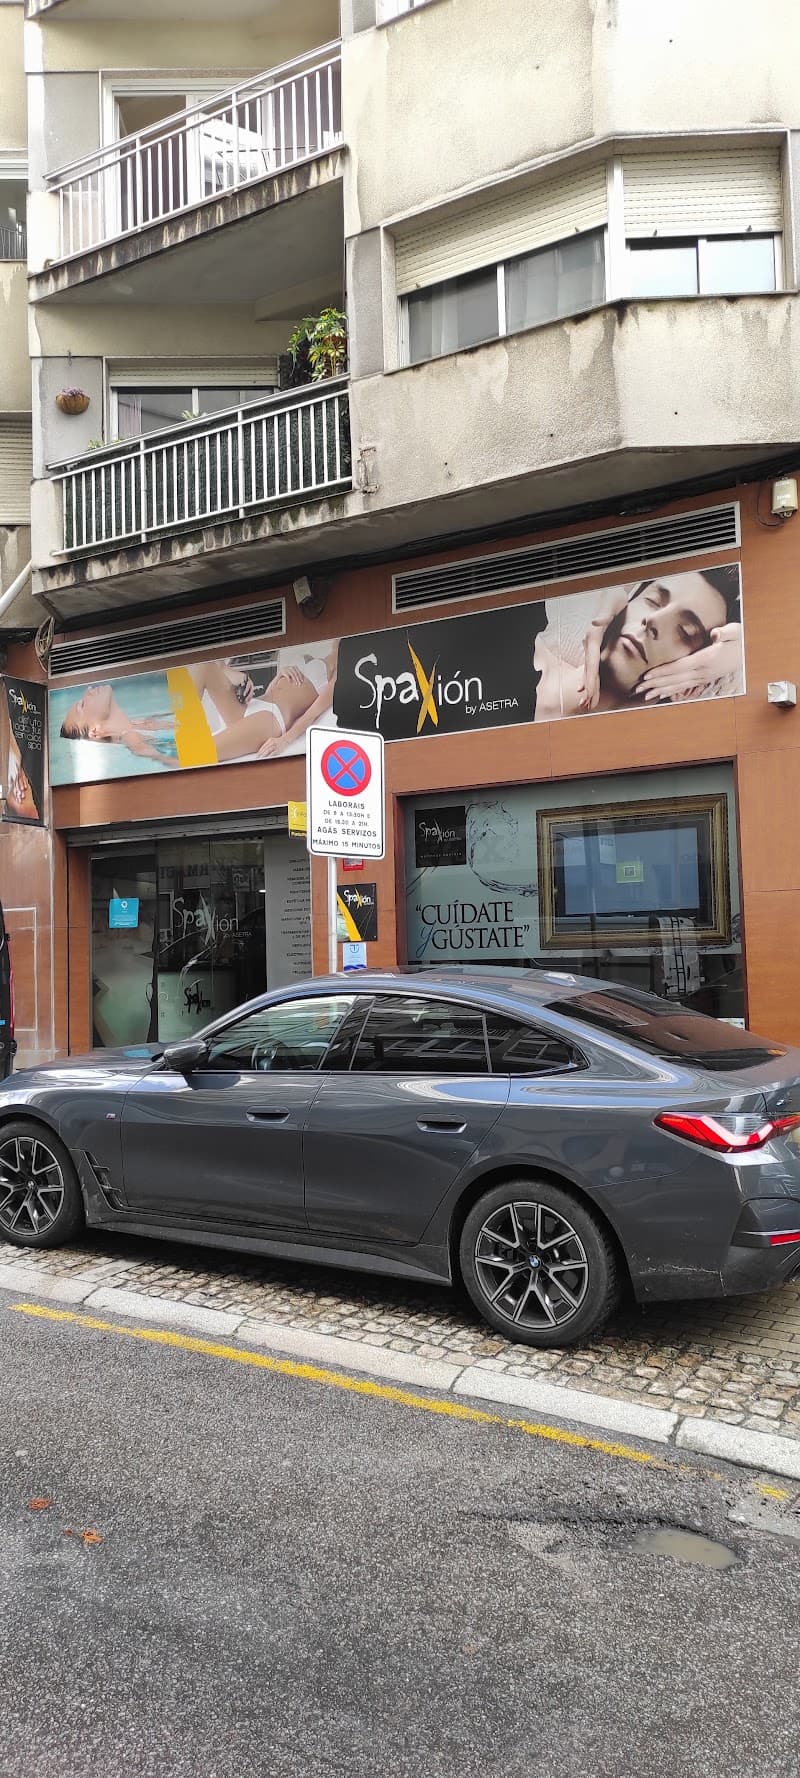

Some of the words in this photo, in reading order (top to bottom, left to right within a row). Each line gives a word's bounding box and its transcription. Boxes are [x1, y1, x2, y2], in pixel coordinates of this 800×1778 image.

[465, 704, 477, 715] by
[478, 698, 519, 713] ASETRA
[328, 800, 365, 810] LABORAIS
[341, 828, 377, 838] SERVIZOS
[312, 837, 339, 847] MÁXIMO
[351, 841, 381, 850] MINUTOS
